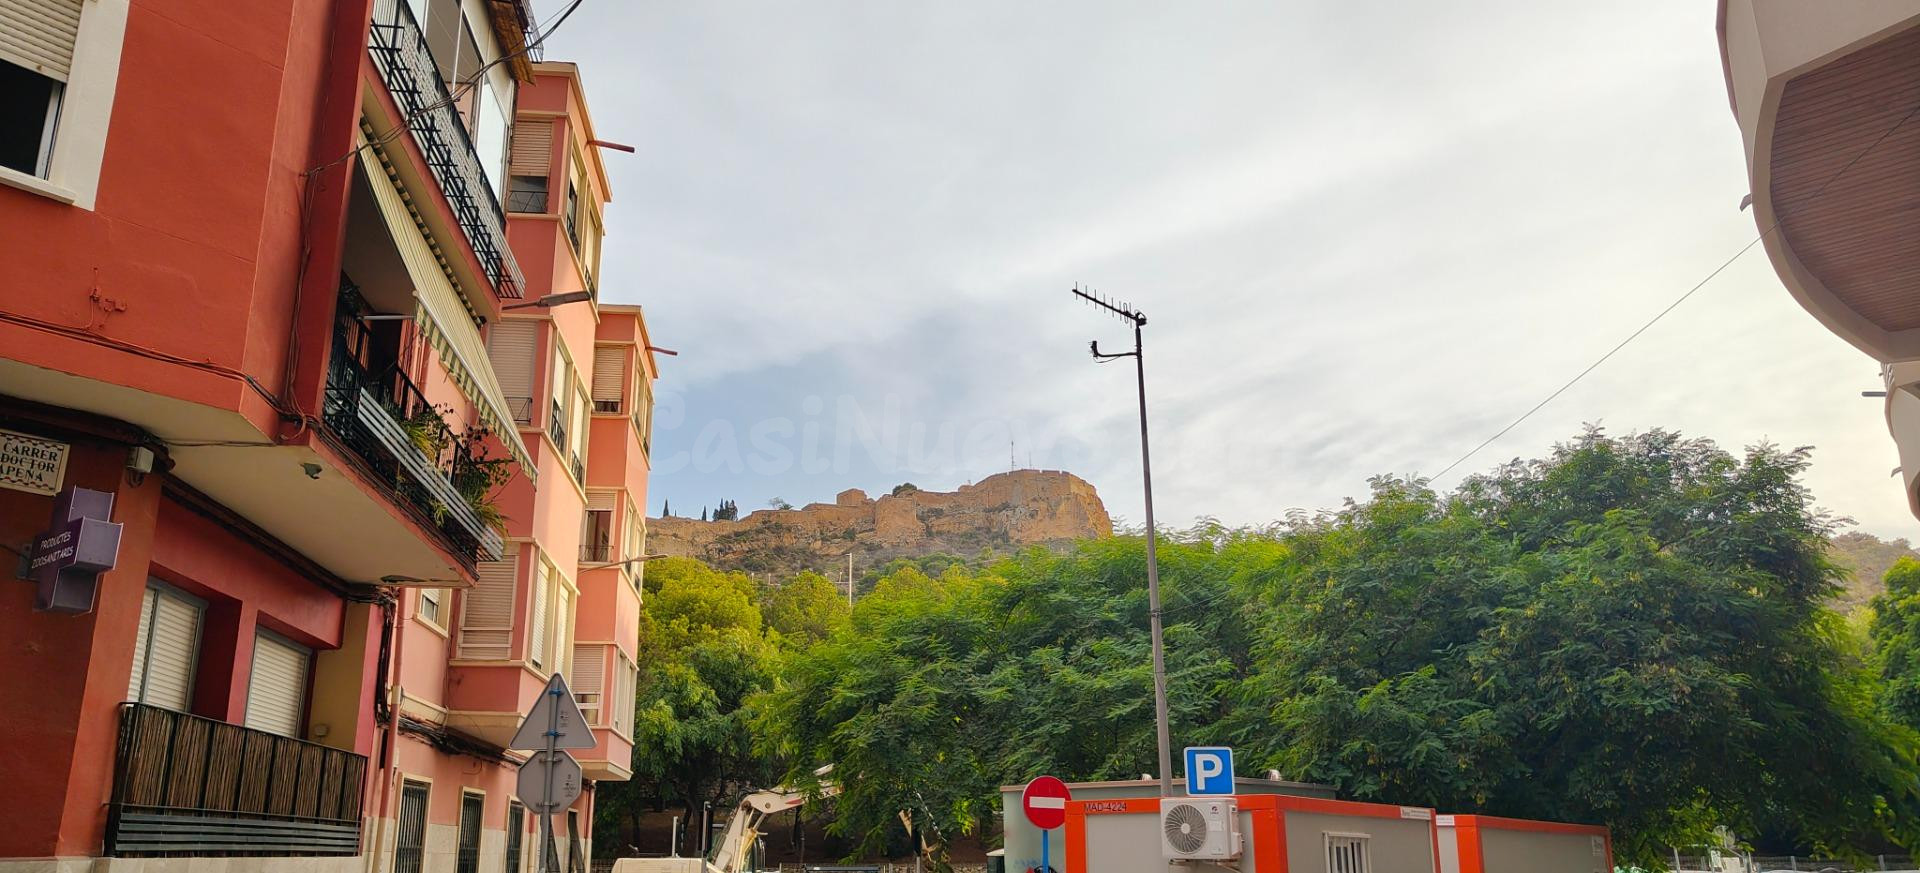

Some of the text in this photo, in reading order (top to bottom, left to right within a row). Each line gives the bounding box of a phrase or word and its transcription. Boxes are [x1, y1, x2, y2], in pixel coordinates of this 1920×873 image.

[3, 442, 58, 461] CARRER
[1, 453, 55, 472] DOCTOR
[1195, 753, 1223, 790] P
